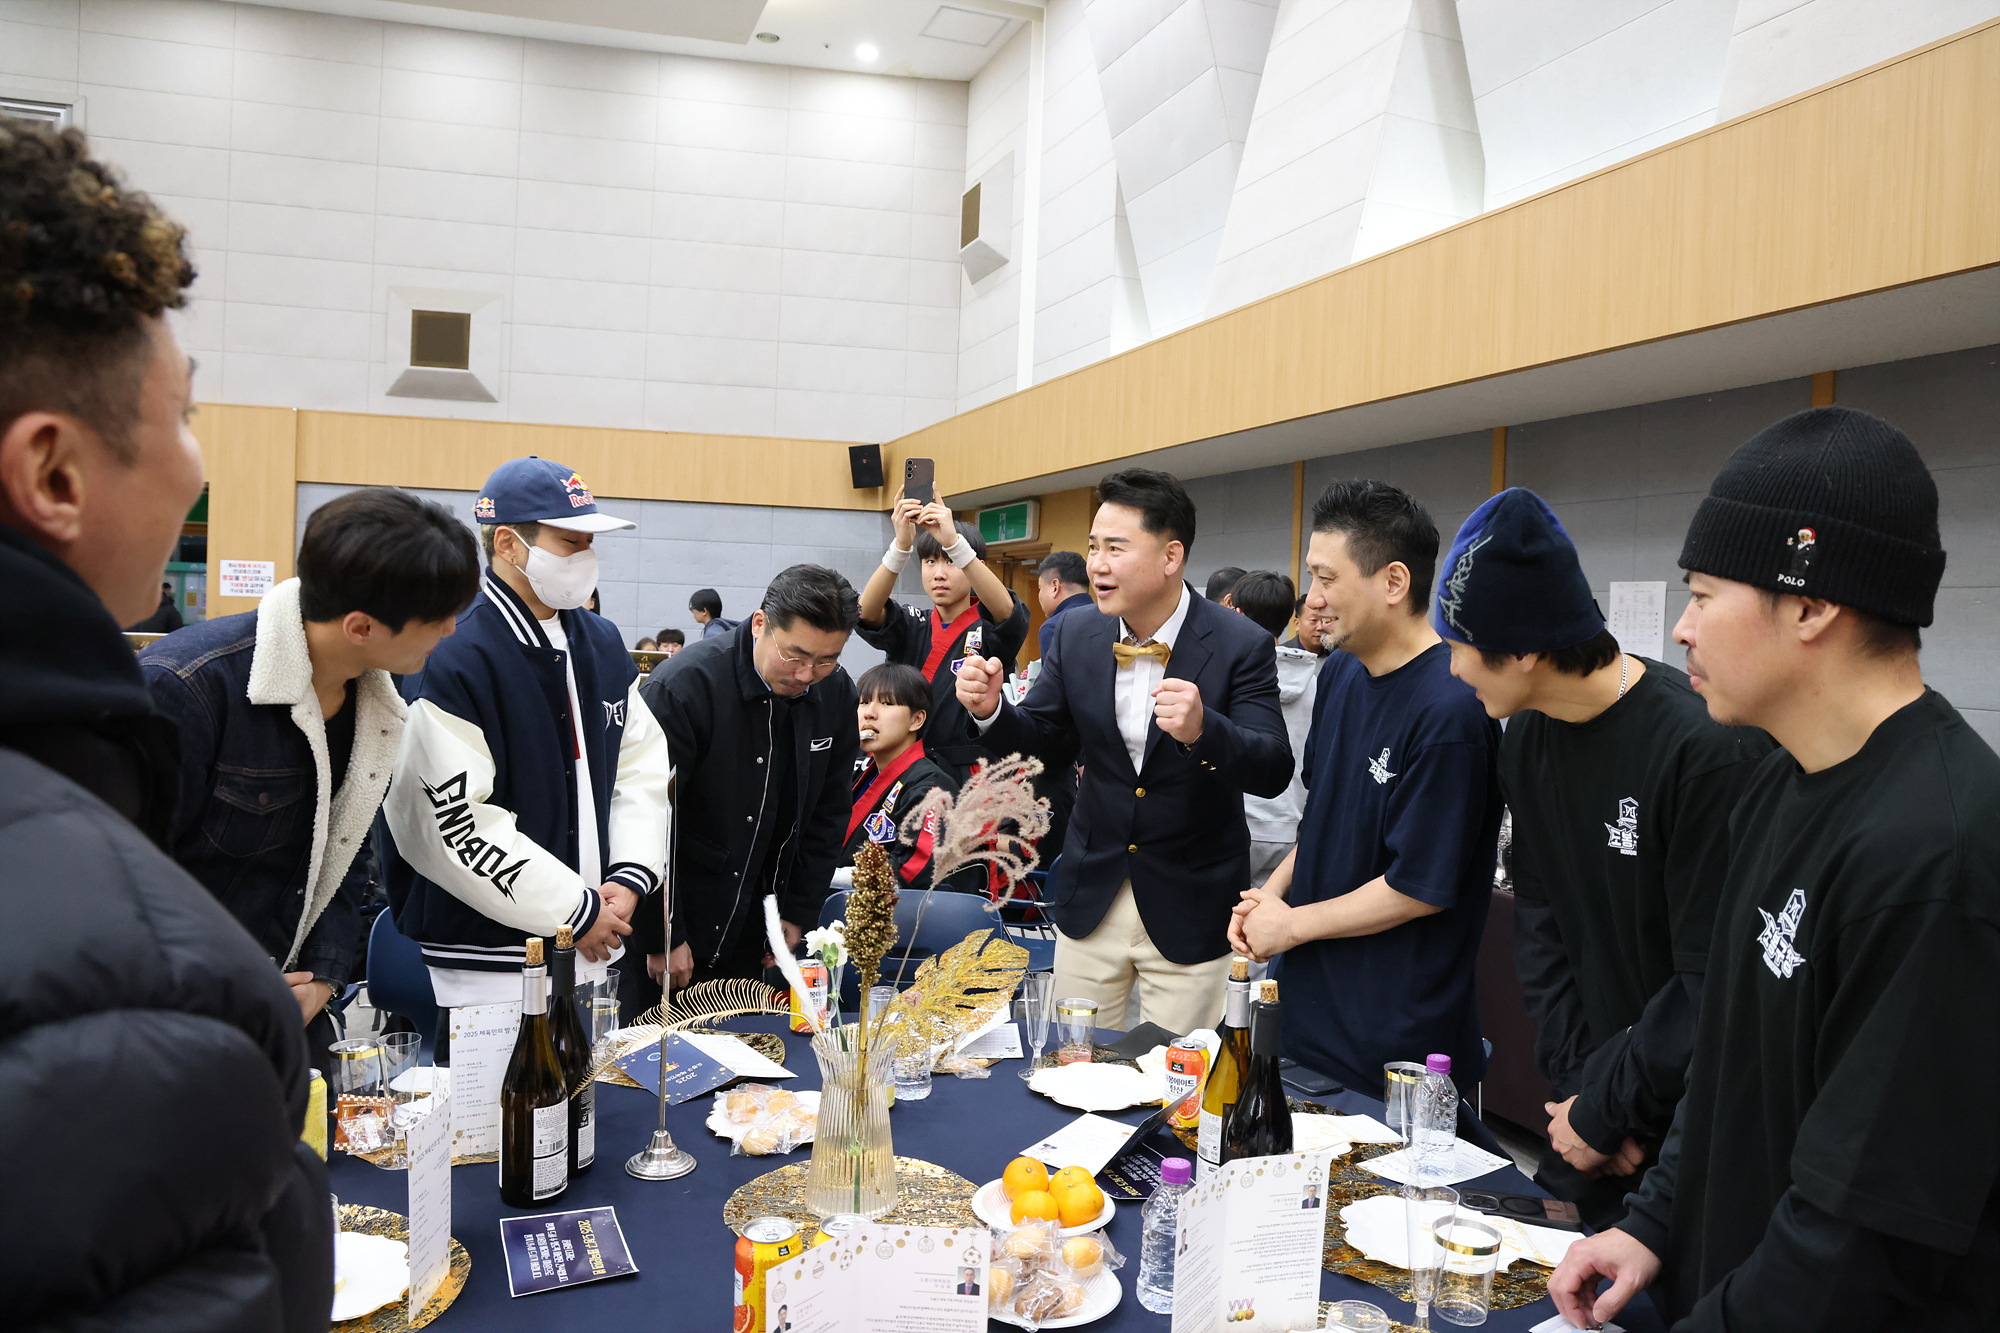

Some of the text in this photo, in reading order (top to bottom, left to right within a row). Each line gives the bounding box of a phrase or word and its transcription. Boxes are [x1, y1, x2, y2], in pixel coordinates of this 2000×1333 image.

[1777, 573, 1805, 587] POLO
[578, 1220, 594, 1234] 2025
[582, 1233, 598, 1249] 도봉구
